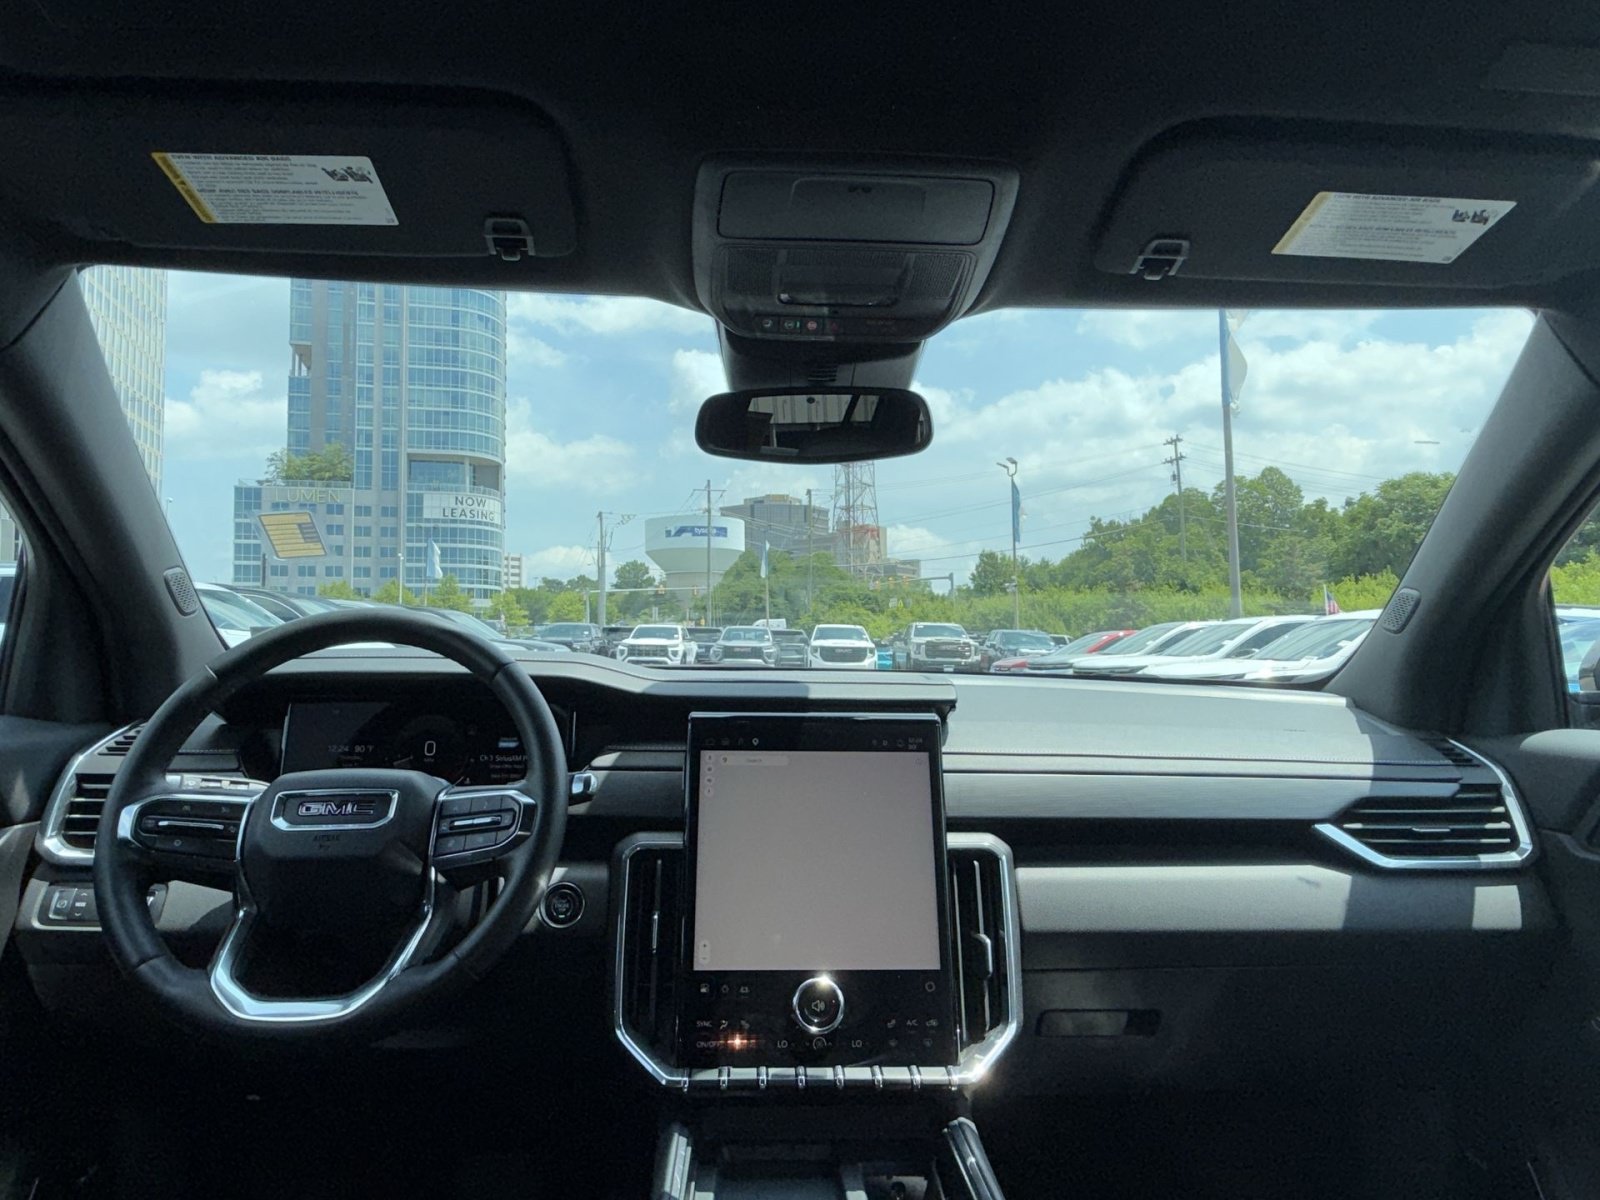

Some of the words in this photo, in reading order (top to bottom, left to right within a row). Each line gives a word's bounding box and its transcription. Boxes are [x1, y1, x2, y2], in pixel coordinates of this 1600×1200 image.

[275, 488, 341, 503] LUMEN
[454, 496, 486, 508] NOW
[442, 507, 496, 521] LEASING
[424, 740, 437, 757] 0
[298, 801, 377, 816] GMC
[777, 1039, 789, 1049] LO
[851, 1039, 863, 1049] LO
